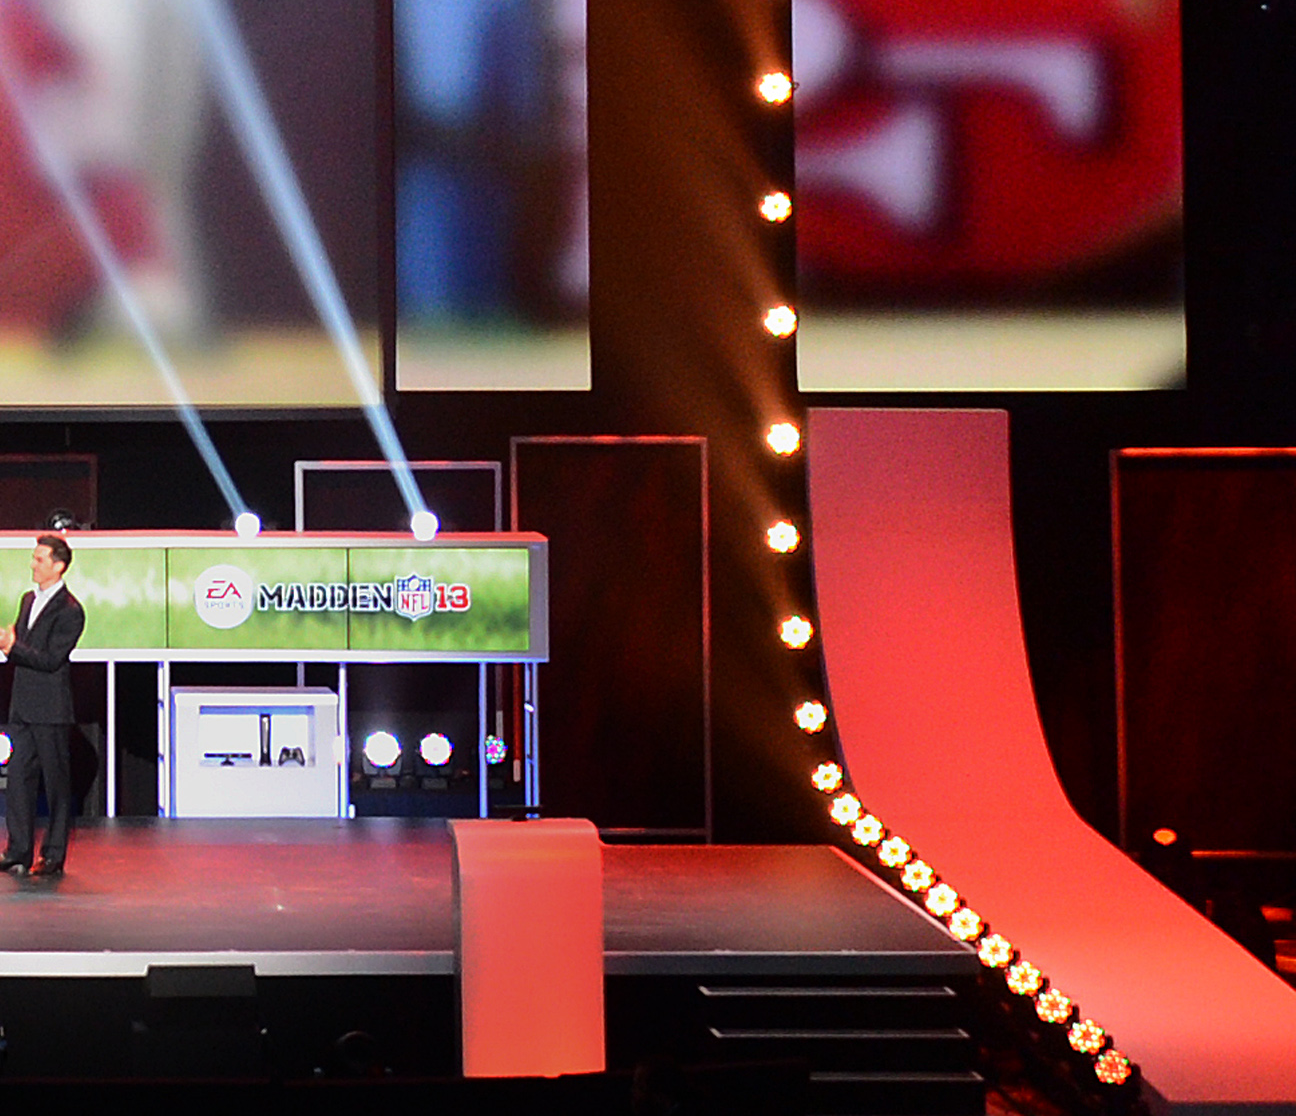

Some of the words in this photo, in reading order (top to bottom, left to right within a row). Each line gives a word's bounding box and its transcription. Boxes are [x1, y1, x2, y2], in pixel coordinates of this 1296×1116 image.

[206, 580, 242, 599] EA
[259, 584, 392, 609] MADDEN
[400, 593, 429, 612] NFL
[436, 585, 469, 609] 13
